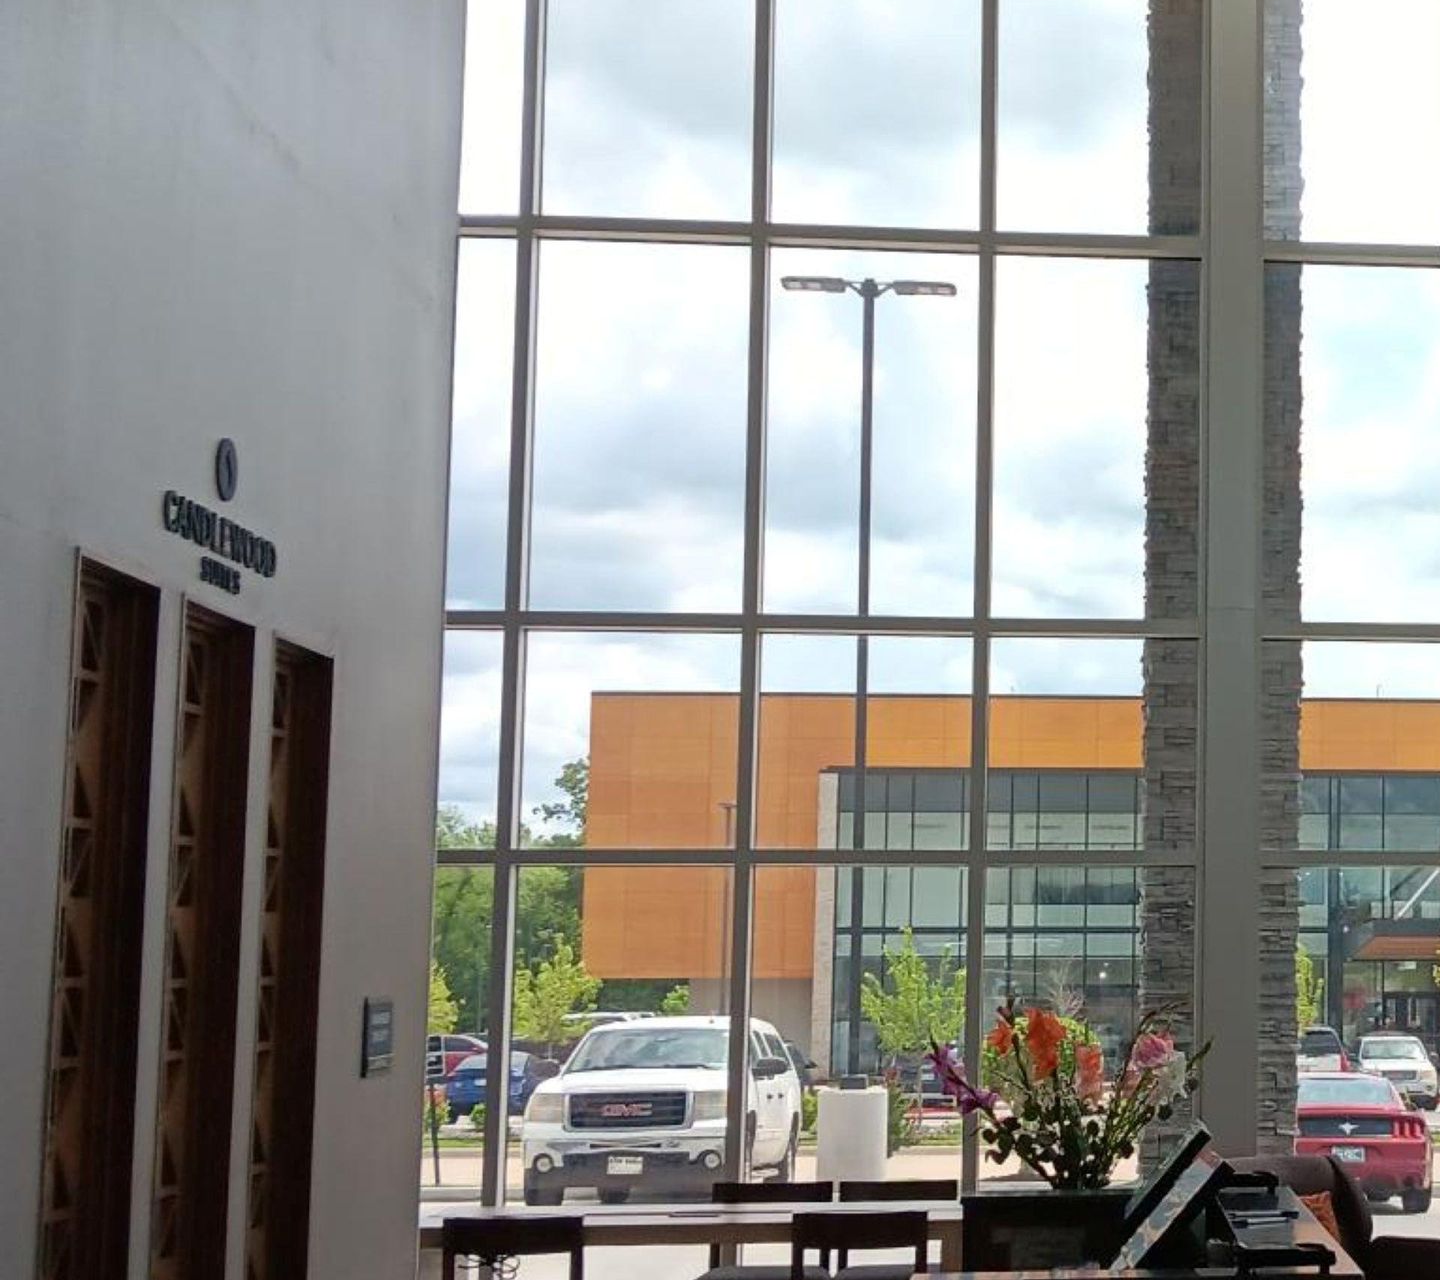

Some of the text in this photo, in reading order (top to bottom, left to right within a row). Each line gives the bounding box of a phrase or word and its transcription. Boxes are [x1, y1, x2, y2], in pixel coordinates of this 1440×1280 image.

[163, 489, 278, 579] CANDLEWOOD
[199, 555, 241, 596] SUITES
[601, 1103, 653, 1117] GMC
